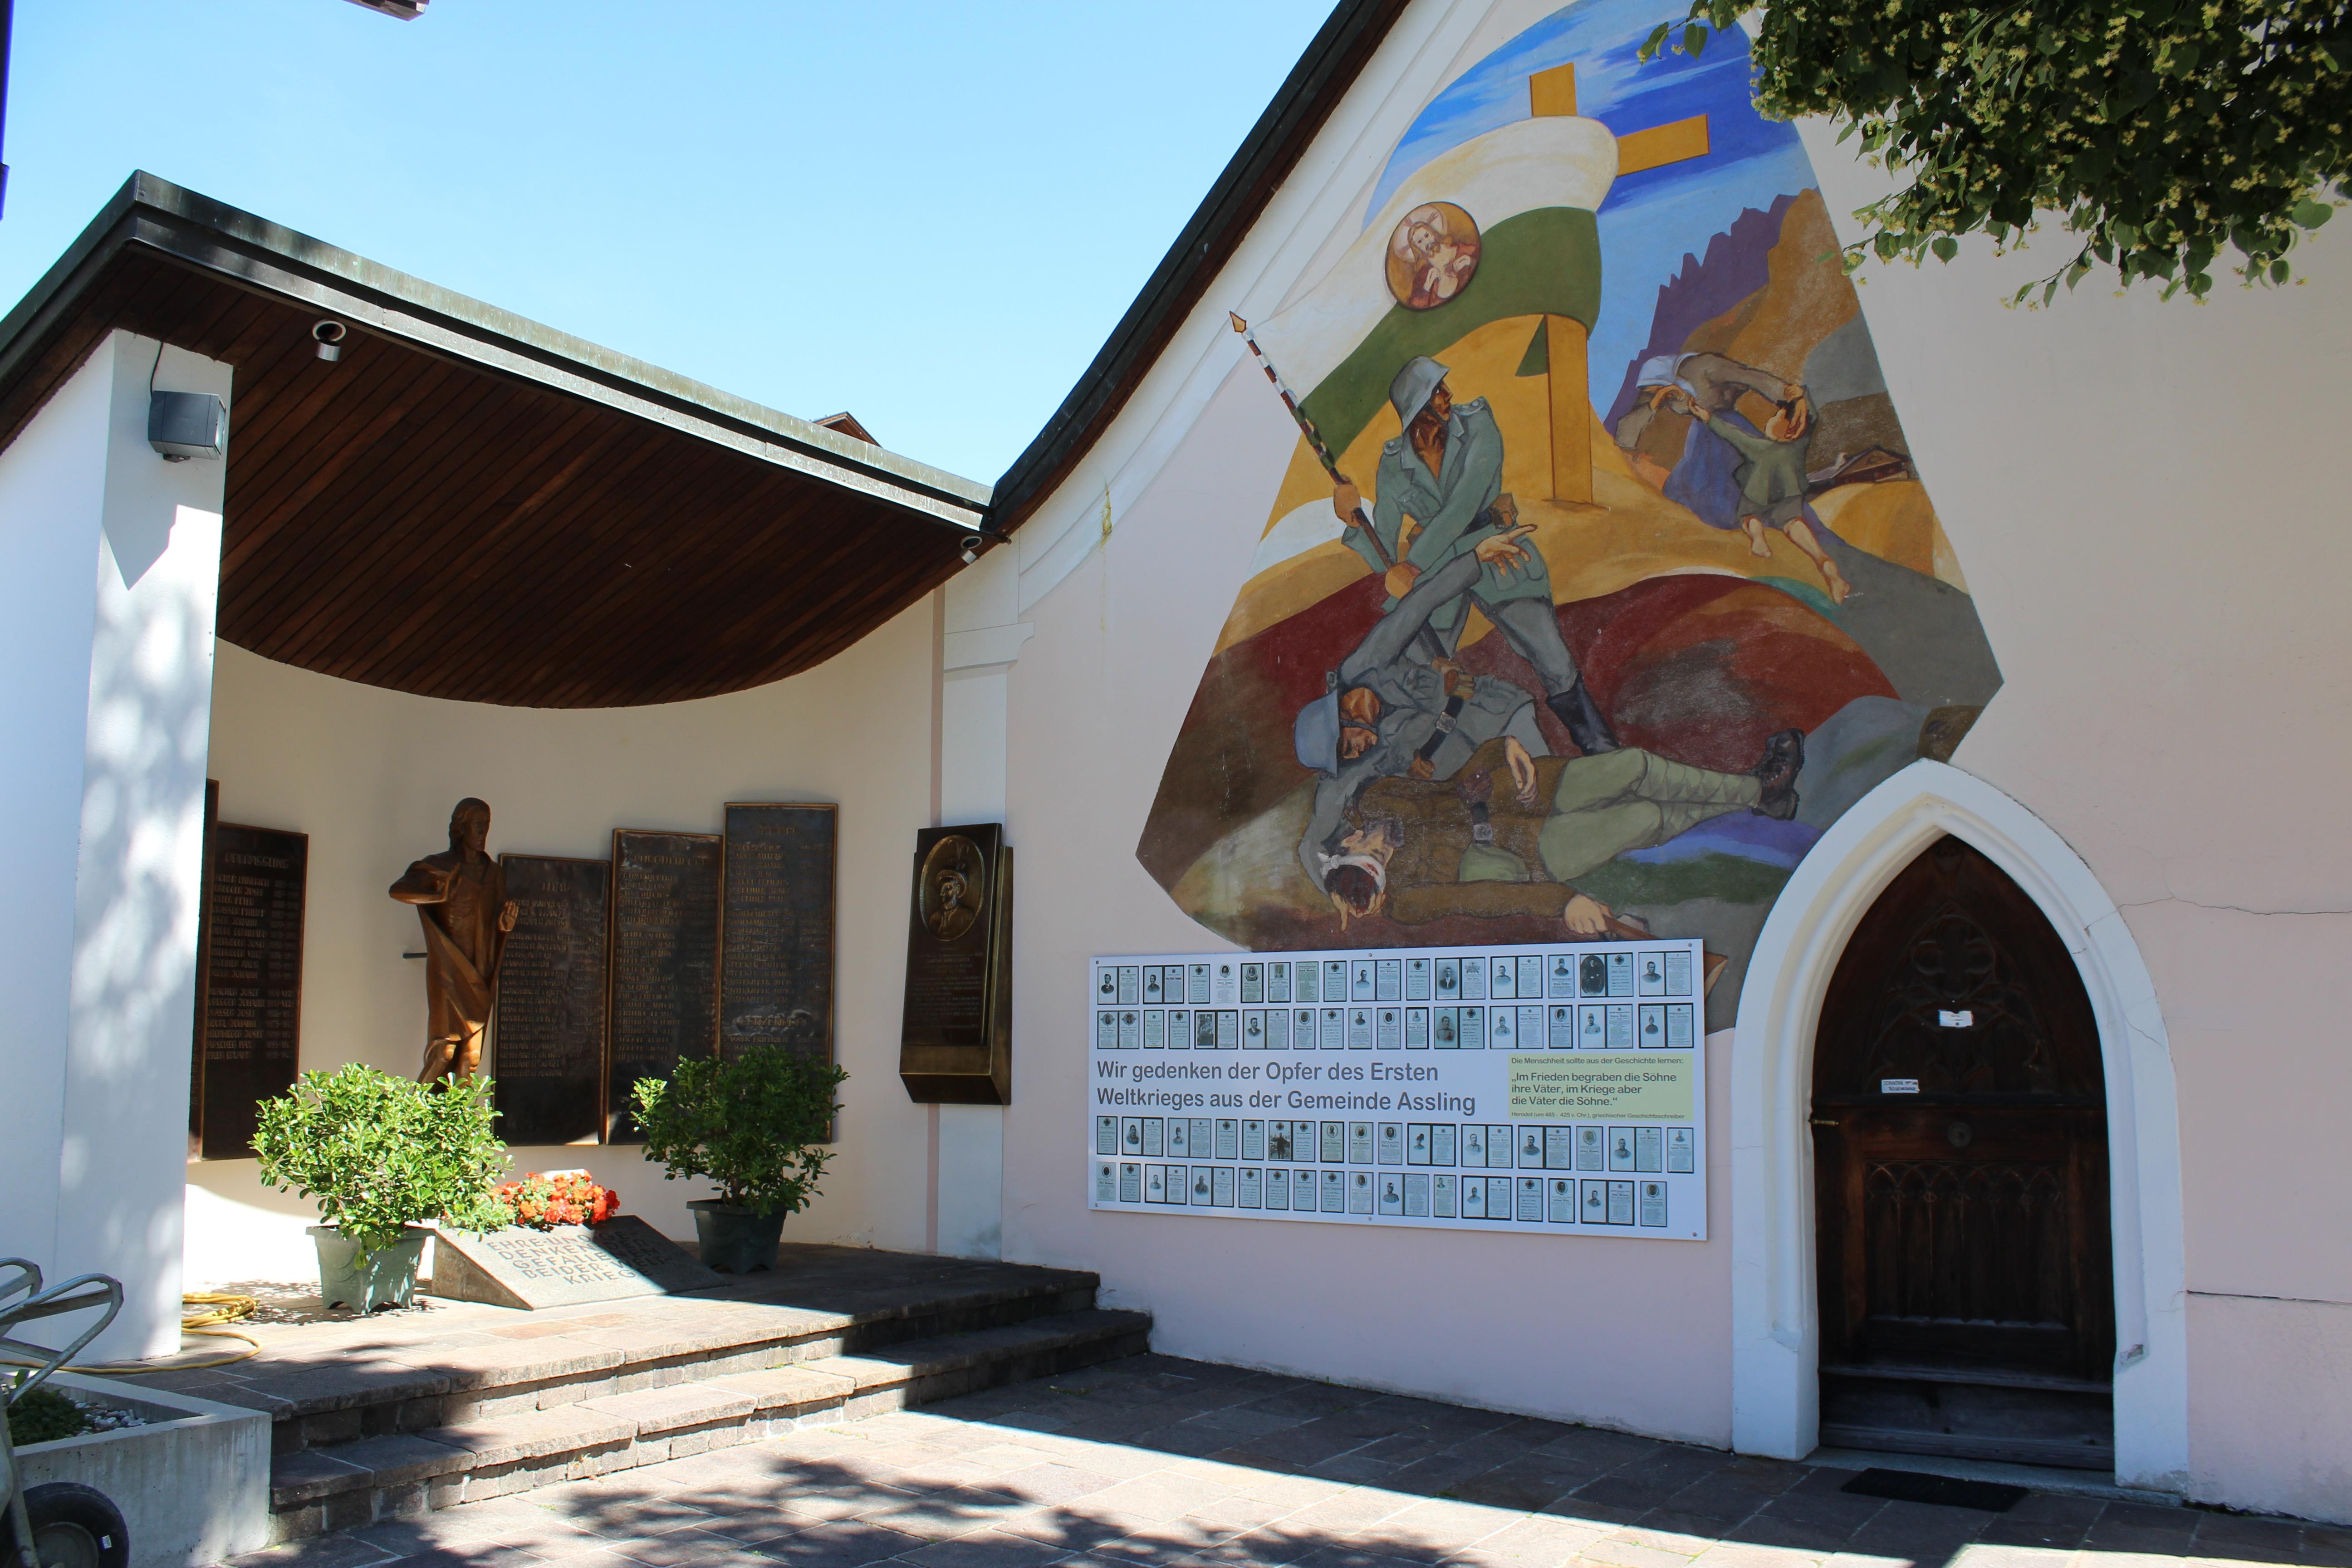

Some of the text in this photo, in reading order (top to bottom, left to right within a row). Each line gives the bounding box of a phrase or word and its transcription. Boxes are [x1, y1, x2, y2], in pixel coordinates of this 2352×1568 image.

[1097, 1060, 1438, 1084] Wir gedenken der Opfer des Ersten
[1531, 1073, 1569, 1081] Frieden
[1572, 1073, 1622, 1083] begraben
[1624, 1073, 1640, 1081] die
[1642, 1073, 1676, 1081] Söhne
[1511, 1084, 1642, 1096] ihre Väter, im Kriege aber
[1097, 1088, 1475, 1116] Weltkrieges aus der Gemeinde Assling
[1511, 1096, 1527, 1105] die
[1529, 1096, 1556, 1105] Väter
[1559, 1097, 1574, 1105] die
[498, 1244, 598, 1260] DENKEN
[522, 1263, 603, 1279] BEIDER
